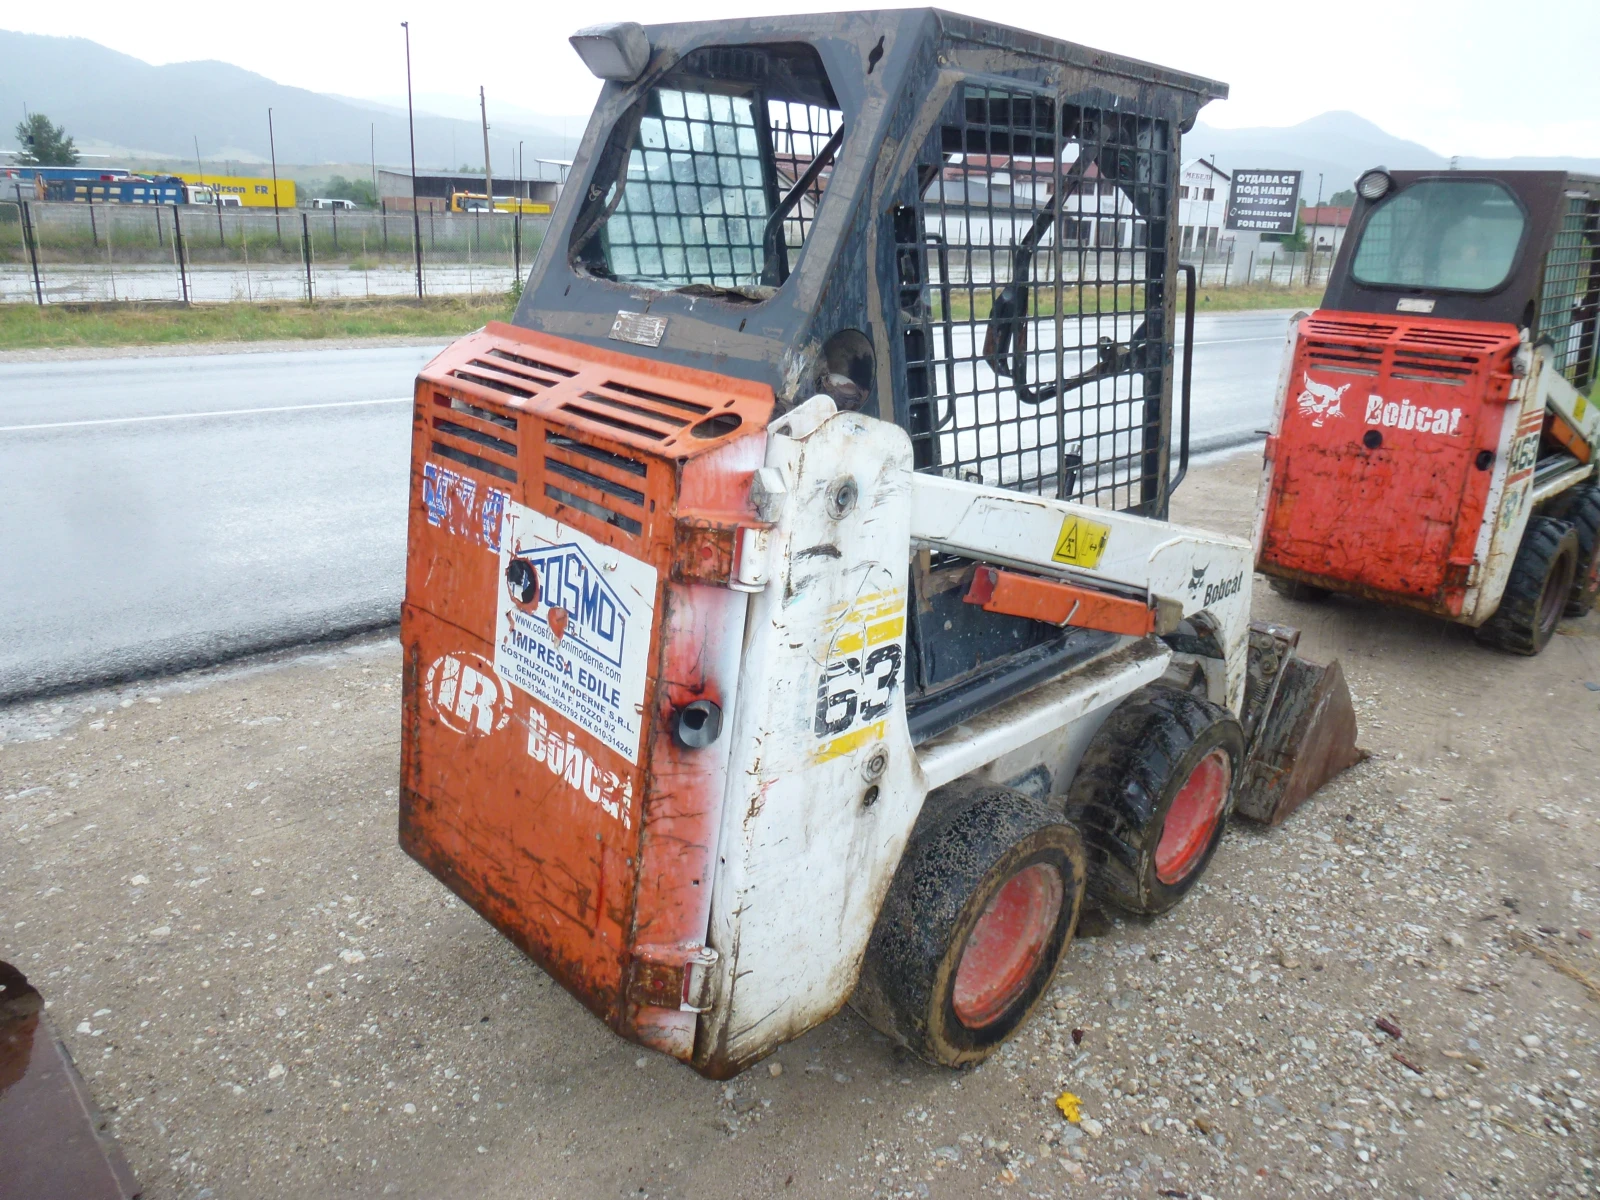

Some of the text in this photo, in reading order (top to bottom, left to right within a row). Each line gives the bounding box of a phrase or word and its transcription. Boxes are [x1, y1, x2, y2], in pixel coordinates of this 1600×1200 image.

[254, 185, 268, 194] FR
[1236, 185, 1292, 195] ПОД НАЕМ
[1237, 174, 1295, 184] ОТДАВА СЕ
[1237, 220, 1280, 229] FOR RENT
[1365, 394, 1462, 436] Bobcat
[1203, 571, 1243, 608] Bobcat
[501, 644, 635, 734] COSTRUZIONI MODERNE S.R.L.
[511, 629, 620, 709] IMPRESA EDILE
[438, 654, 498, 735] IR
[500, 665, 513, 679] TEL.
[579, 714, 592, 730] FAX
[593, 725, 633, 758] 010-314242
[516, 664, 547, 688] GENOVA
[553, 685, 566, 700] VIA
[575, 702, 602, 723] POZZO
[603, 719, 616, 734] 9/2
